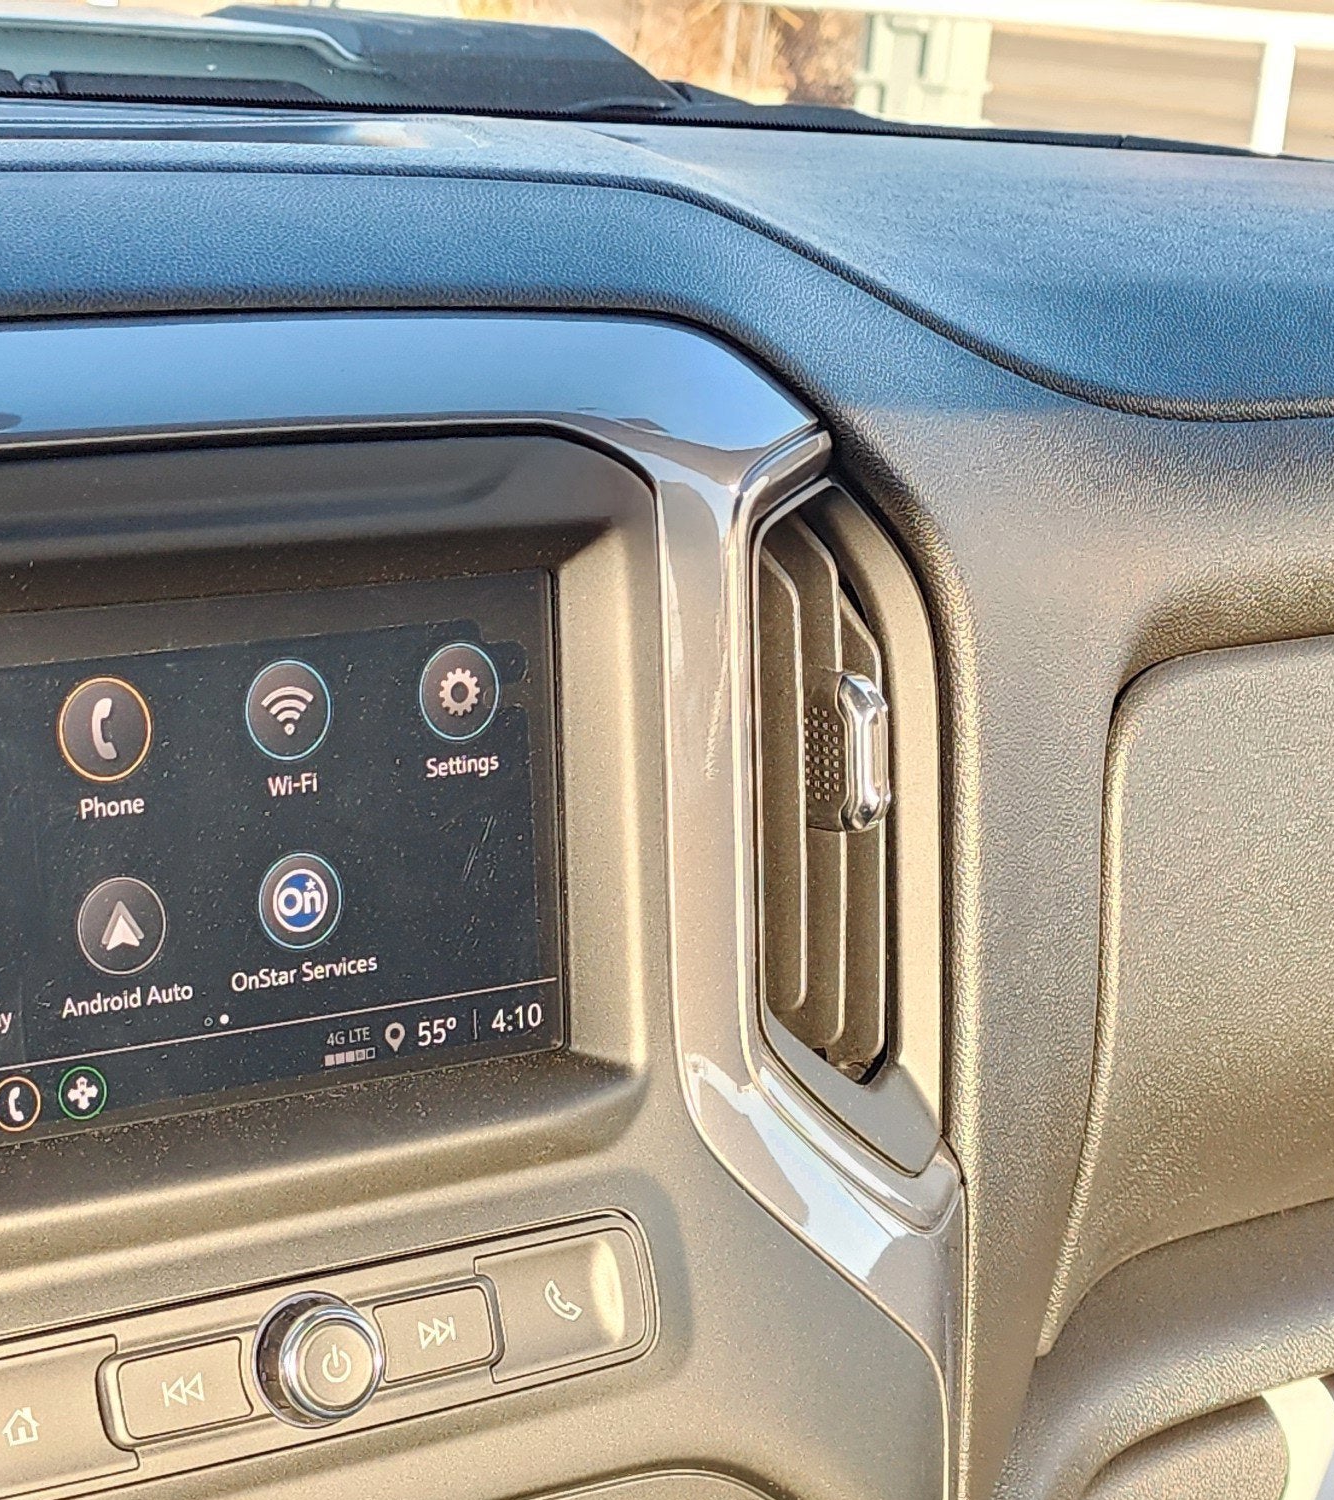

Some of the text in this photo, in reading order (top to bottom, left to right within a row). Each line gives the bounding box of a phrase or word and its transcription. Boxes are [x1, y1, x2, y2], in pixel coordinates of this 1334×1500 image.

[426, 753, 499, 781] Settings
[267, 772, 318, 797] Wi-Fi
[80, 796, 145, 820] Phone
[278, 887, 321, 916] On
[231, 955, 378, 993] OnStar Services
[62, 982, 193, 1019] Android Auto
[491, 1003, 543, 1033] 4:10
[326, 1027, 372, 1046] 4G LTE
